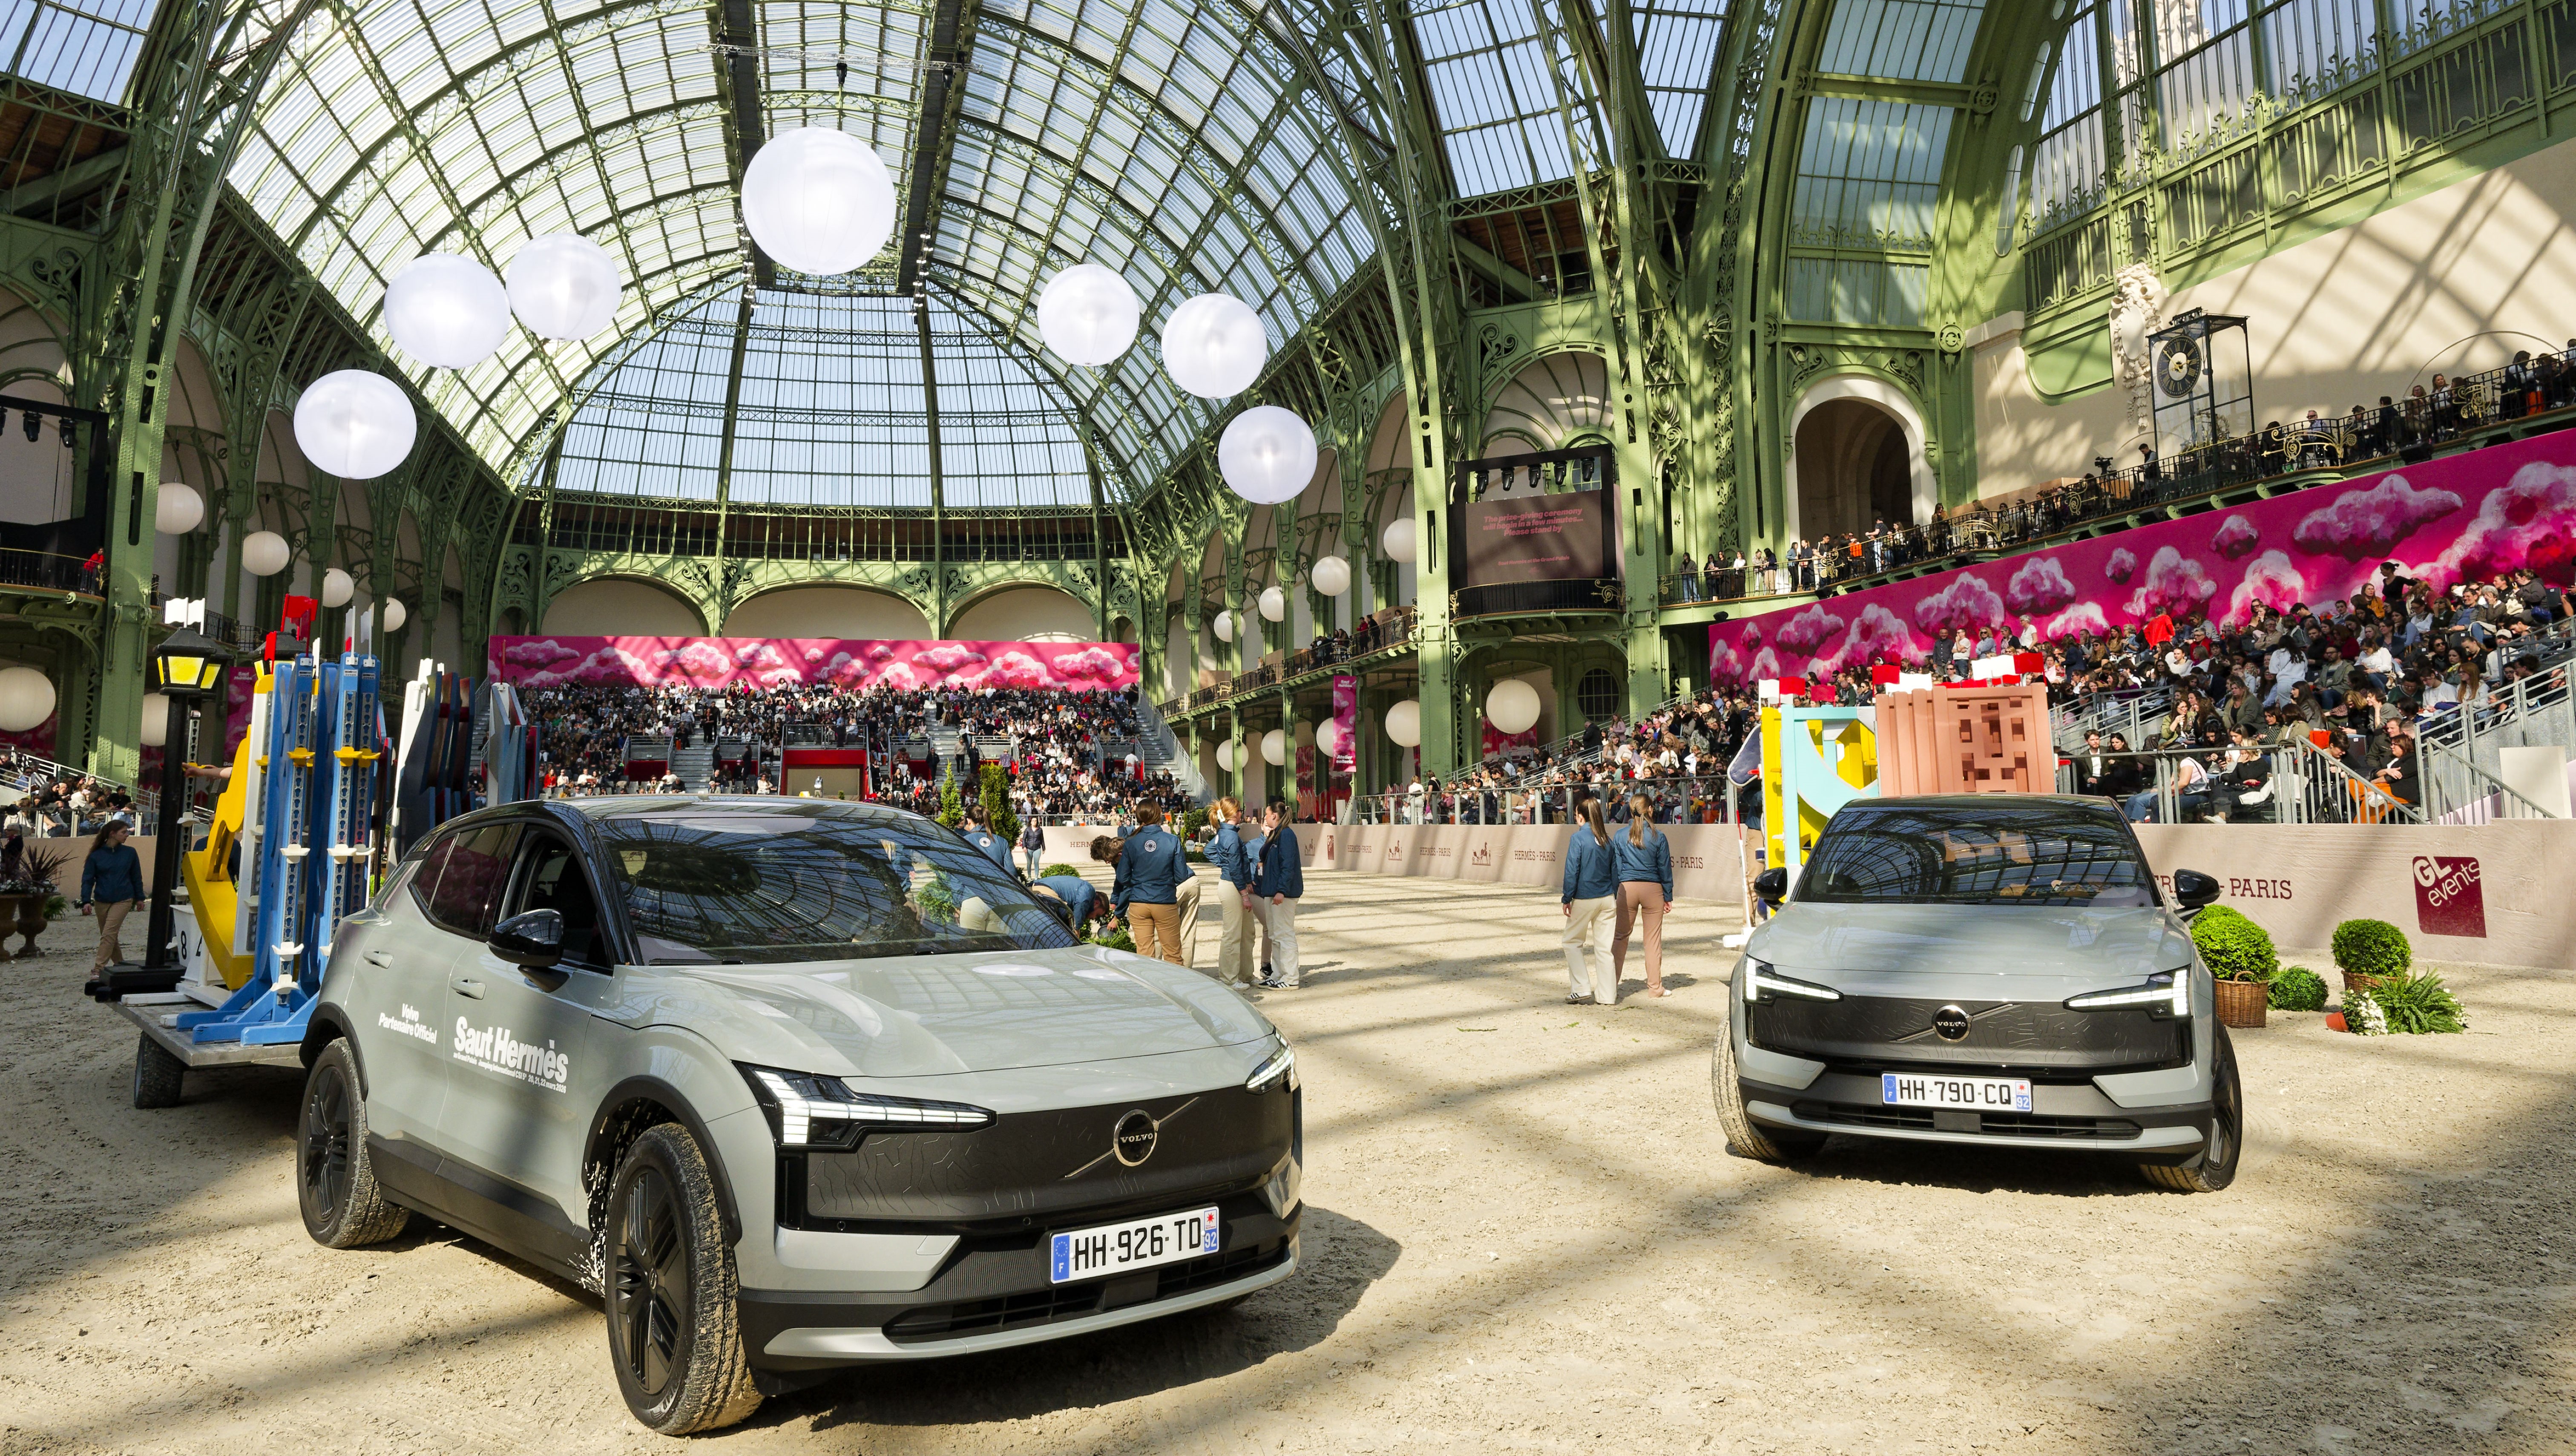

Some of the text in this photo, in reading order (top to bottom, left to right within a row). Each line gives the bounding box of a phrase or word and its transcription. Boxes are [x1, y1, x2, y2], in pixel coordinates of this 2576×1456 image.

[1497, 521, 1517, 530] begin
[1546, 516, 1583, 524] minutes...
[1498, 512, 1543, 523] prize-giving
[1544, 508, 1583, 517] ceremony
[1530, 525, 1552, 534] stand
[1420, 846, 1436, 856] HERMÈS
[1439, 848, 1451, 857] PARIS
[1515, 849, 1535, 860] HERMÈS
[1539, 851, 1555, 861] PARIS
[1680, 857, 1703, 869] PARIS
[2413, 856, 2452, 887] GL
[2229, 878, 2292, 900] PARIS
[2428, 861, 2480, 906] events
[181, 930, 187, 960] 8
[402, 1003, 419, 1022] Volvo
[378, 1012, 437, 1044] Partenaire Officiel
[454, 1016, 569, 1083] Saut Hermès
[540, 1078, 546, 1087] 22
[545, 1082, 556, 1090] mars
[556, 1083, 566, 1094] 2026
[1899, 1079, 2011, 1105] HH-790-CQ
[2017, 1096, 2029, 1108] 92
[1120, 1133, 1153, 1143] VOLVO
[1059, 1217, 1216, 1273] F HH-926-TD 92
